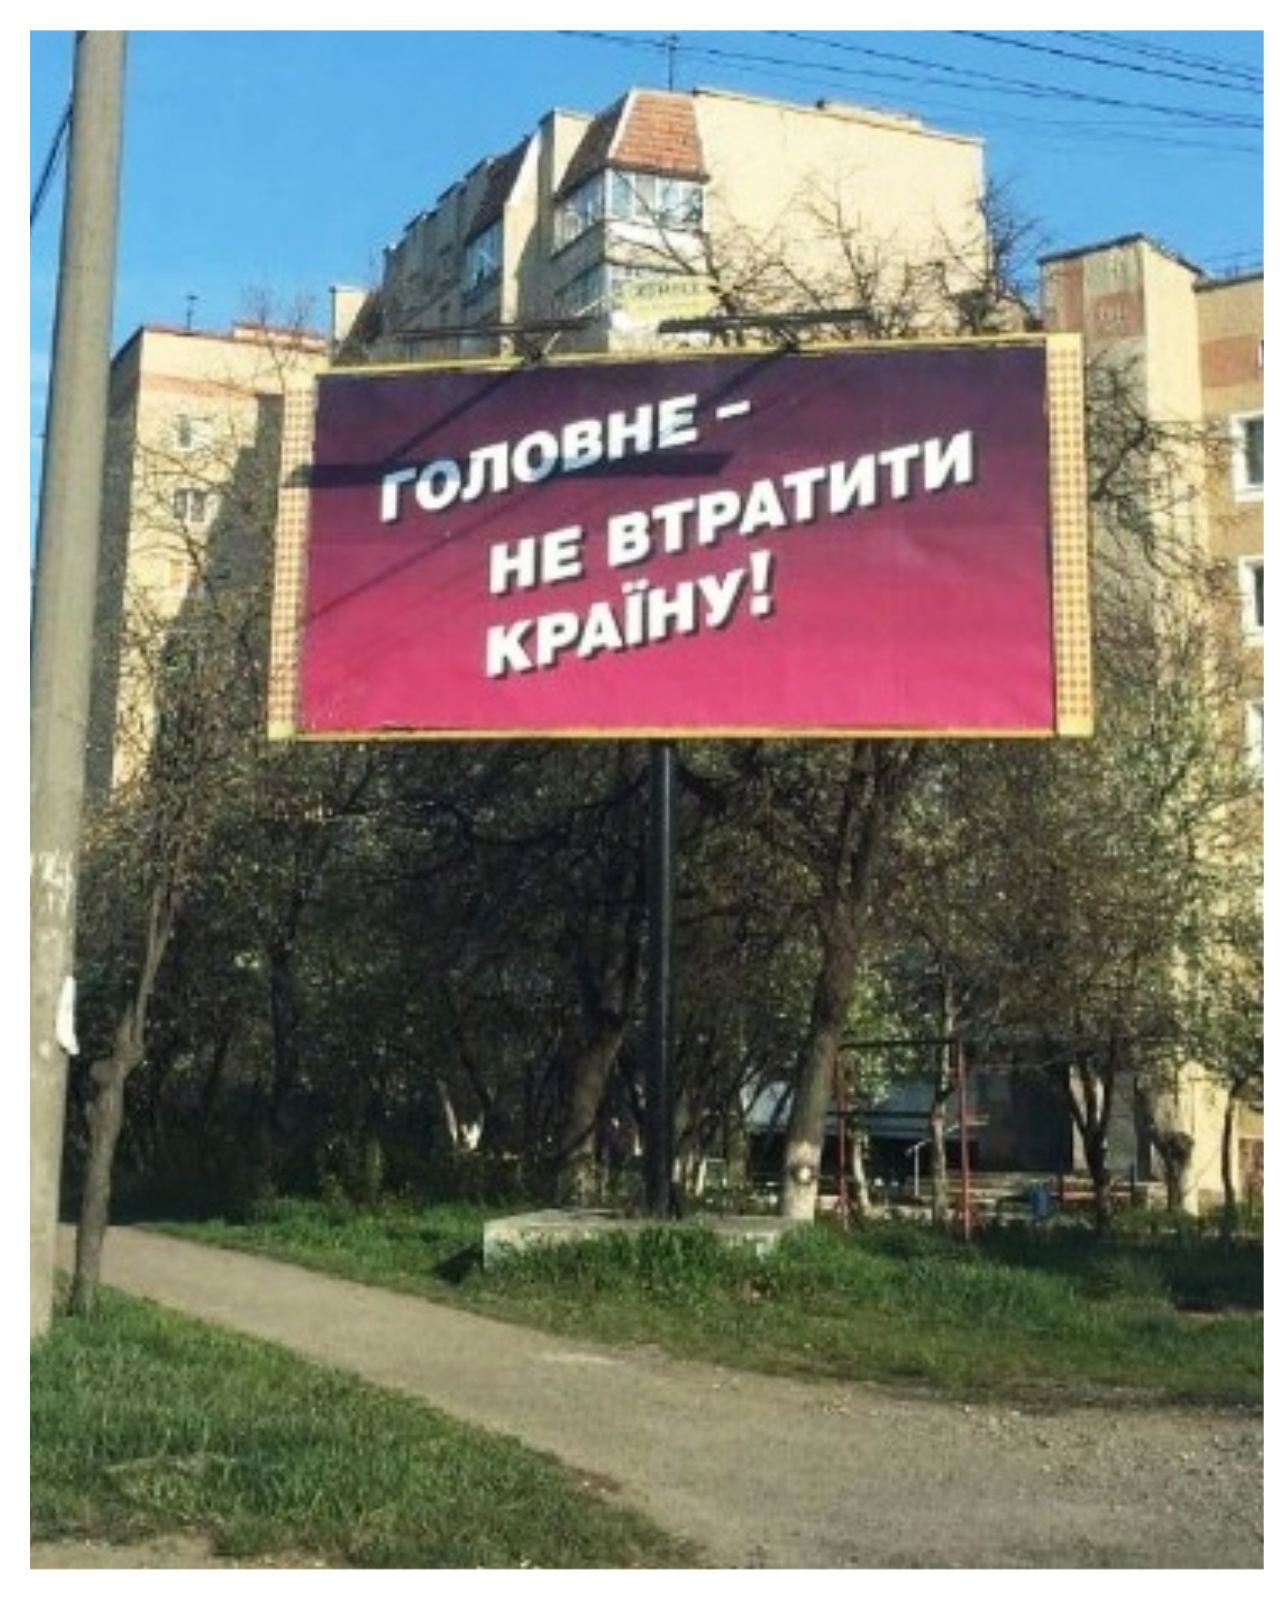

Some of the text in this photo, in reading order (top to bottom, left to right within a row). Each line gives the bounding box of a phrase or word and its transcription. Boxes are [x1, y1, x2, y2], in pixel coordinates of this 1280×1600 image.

[380, 394, 699, 522] ГОЛОВНЕ
[489, 430, 975, 594] НЕ ВТРАТИТИ
[485, 549, 774, 678] КРАЇНУ!
